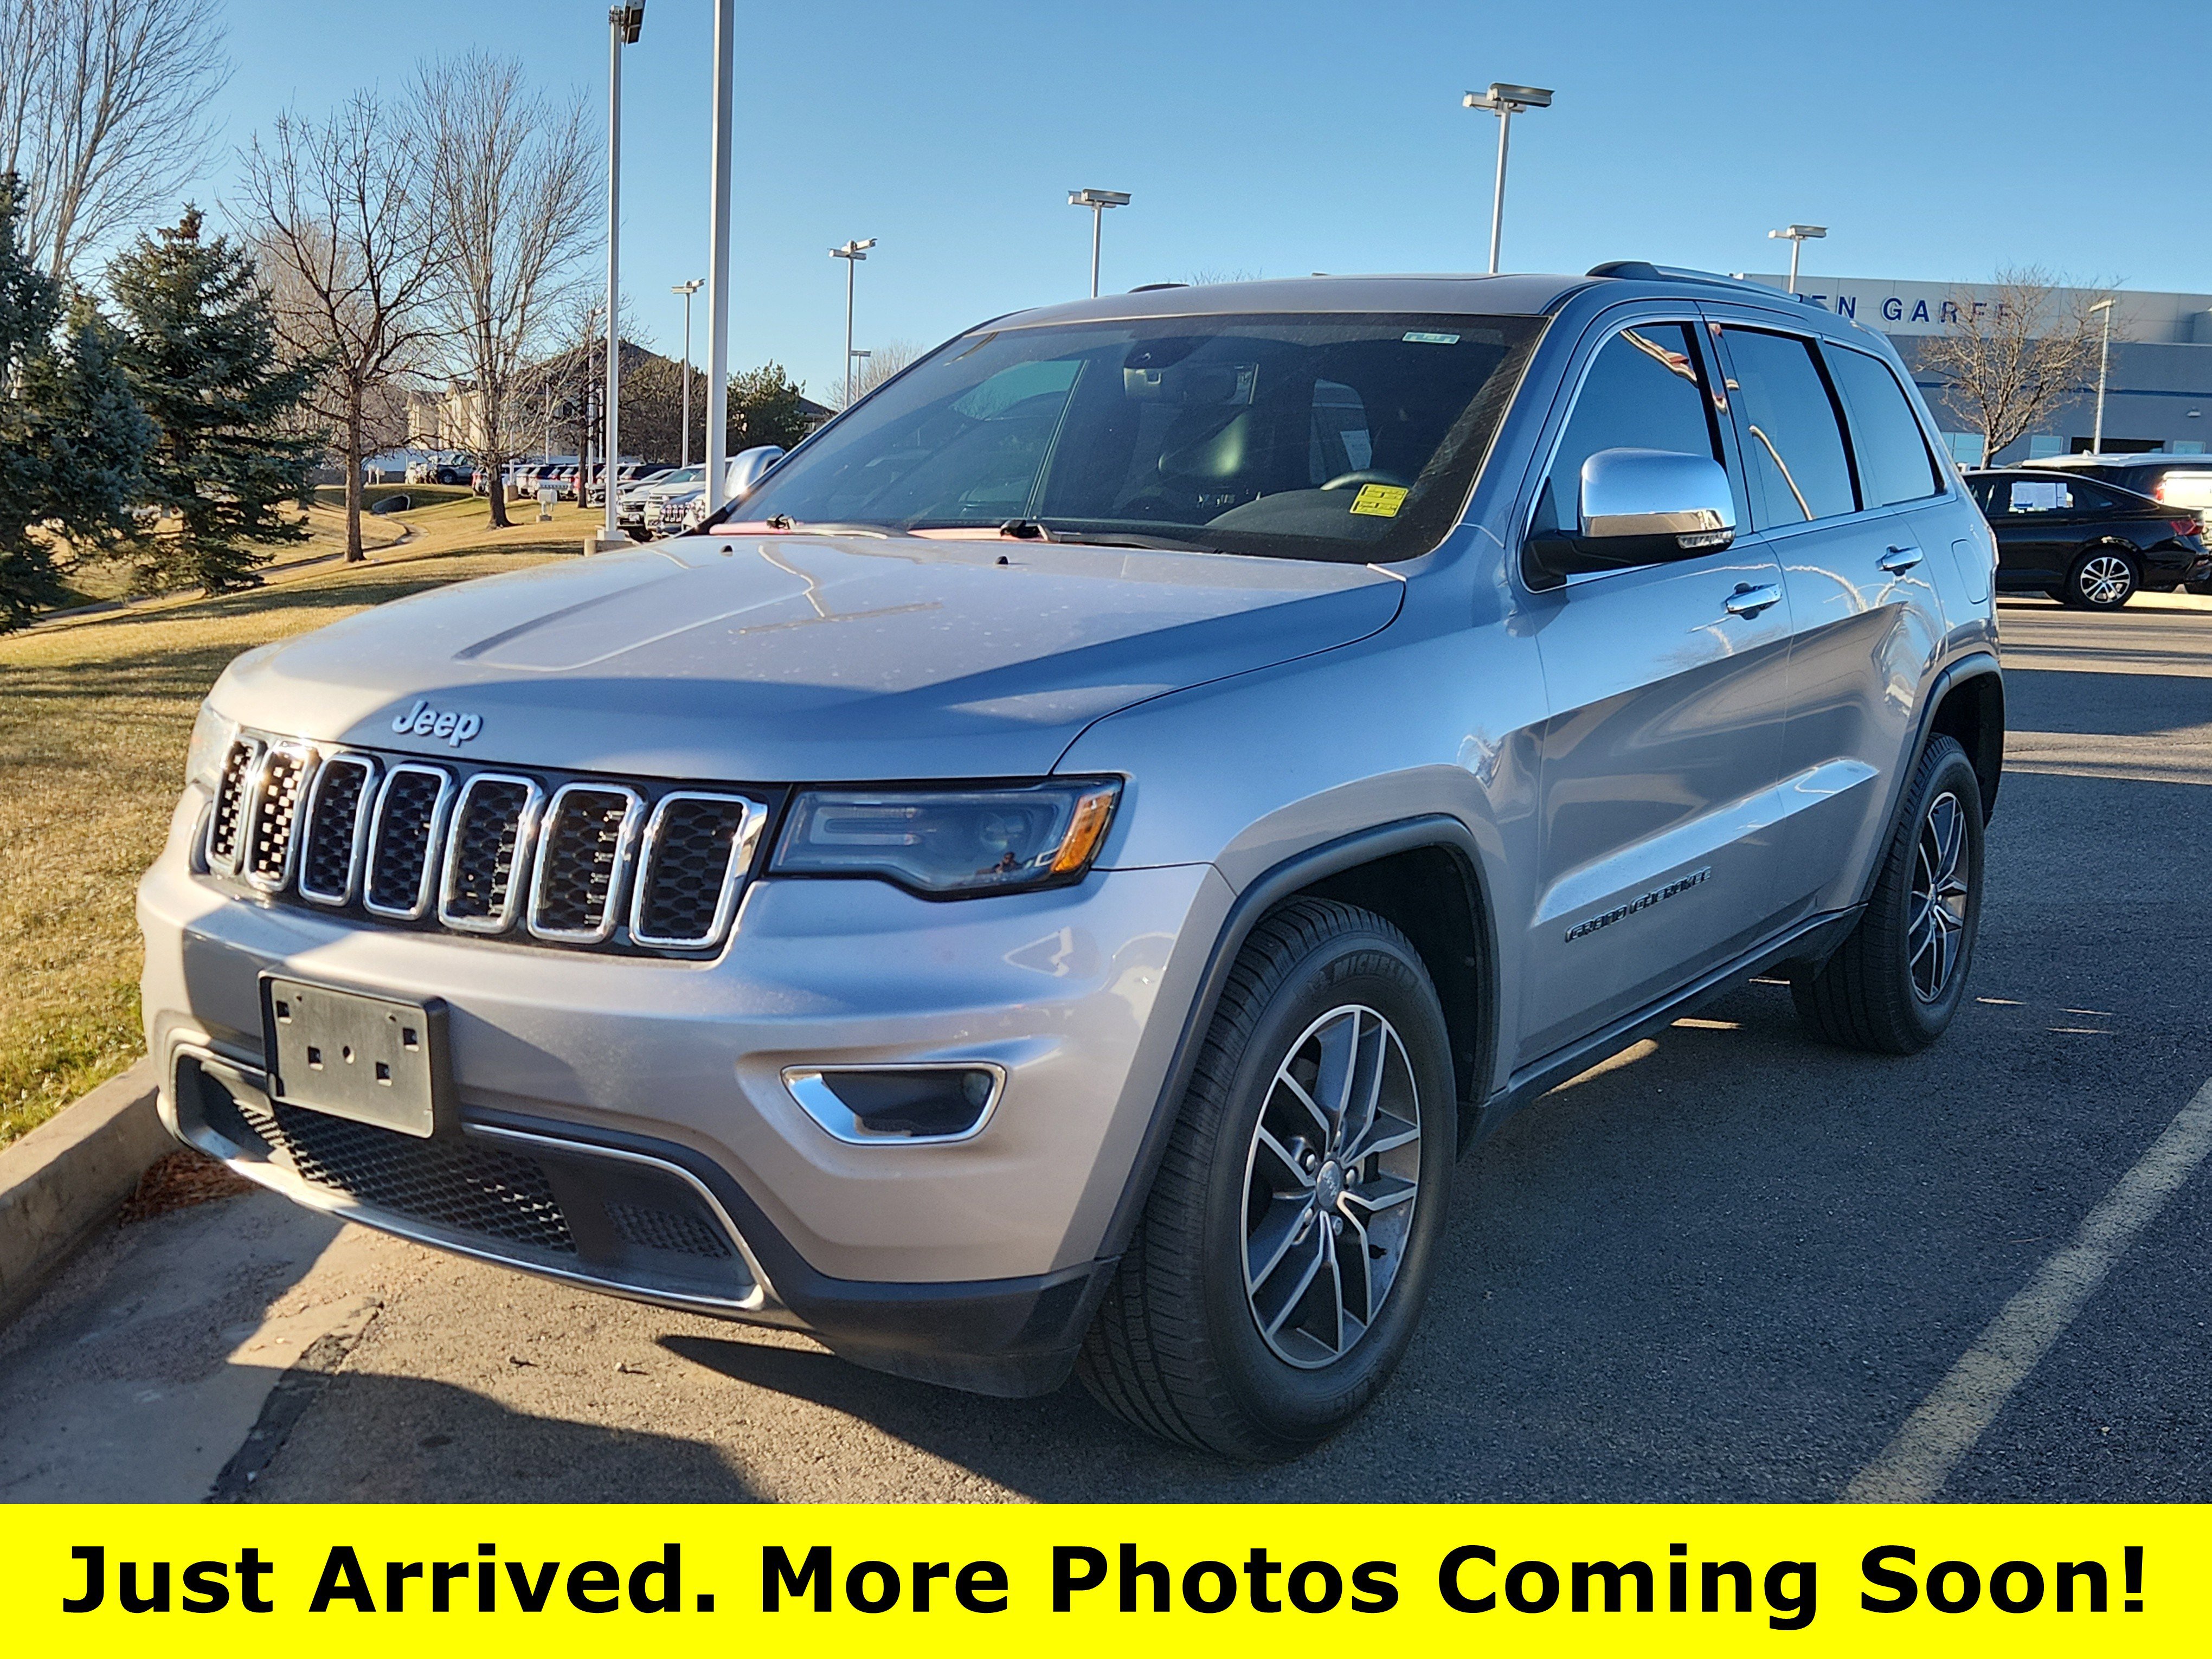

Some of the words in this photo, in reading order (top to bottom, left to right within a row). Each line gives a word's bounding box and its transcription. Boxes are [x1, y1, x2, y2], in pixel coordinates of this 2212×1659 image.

[1811, 295, 1856, 319] N
[392, 699, 483, 748] Jeep
[1565, 904, 1627, 943] GRAND
[1629, 866, 1712, 915] CHEROKEE
